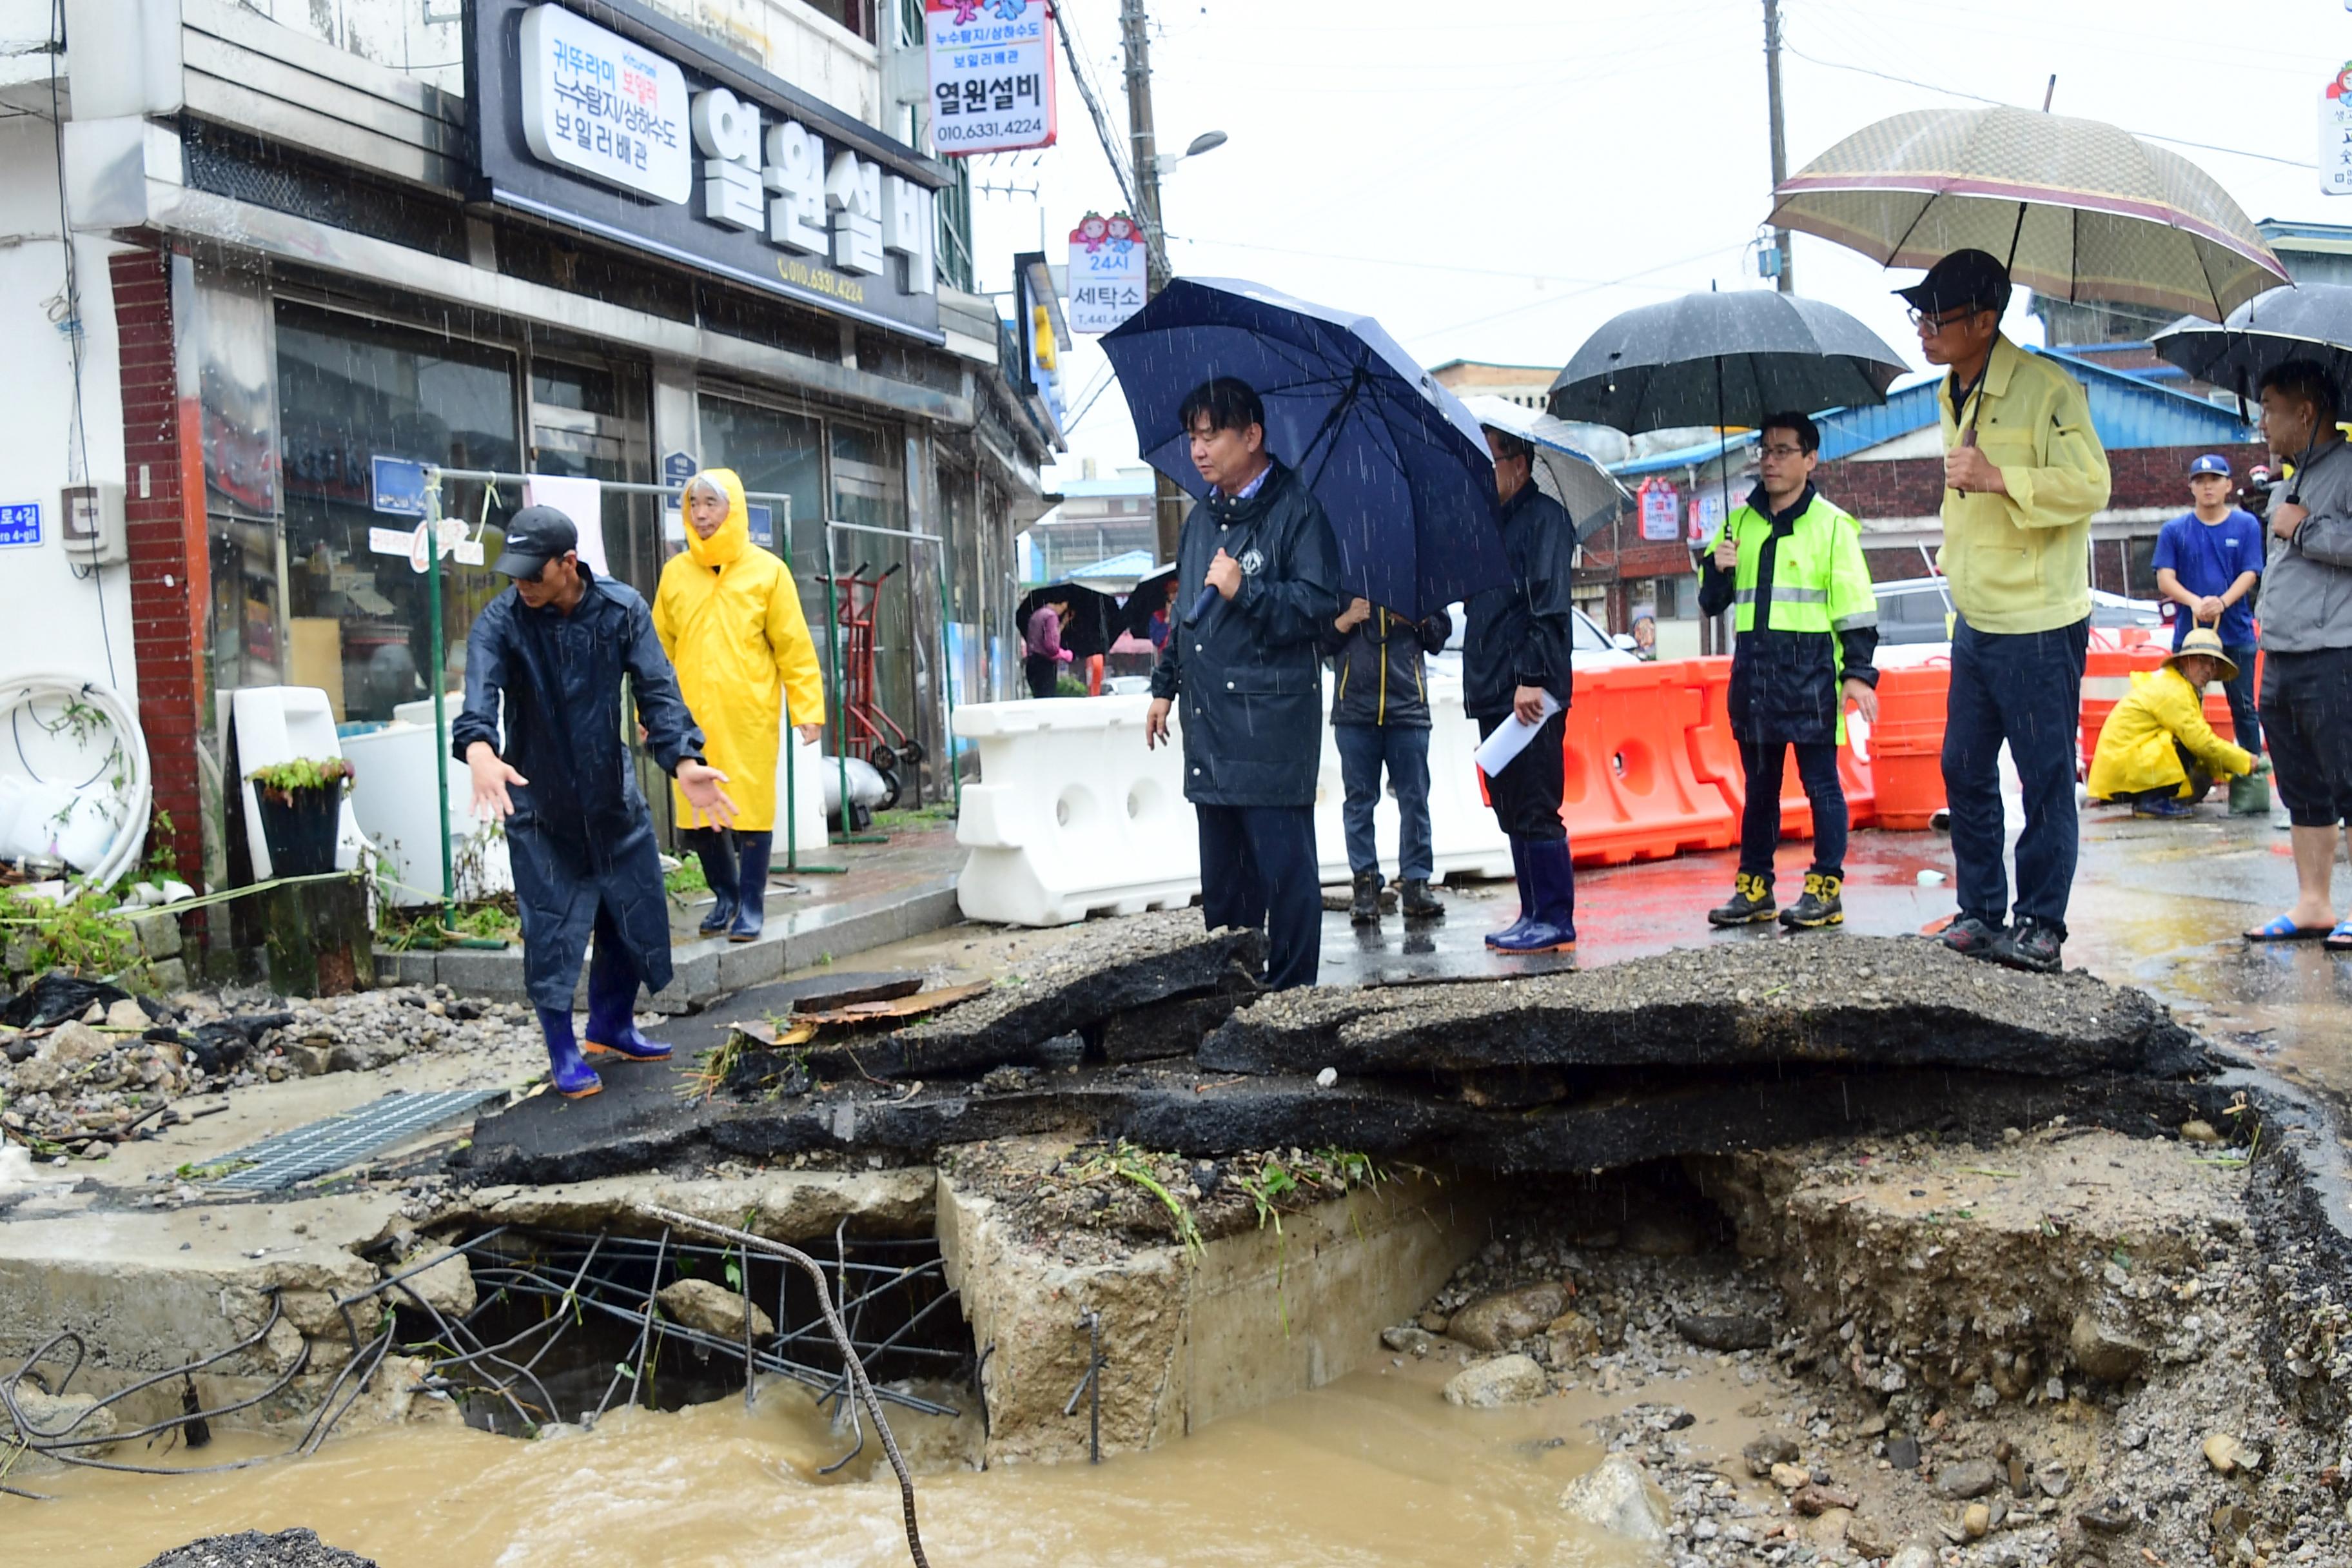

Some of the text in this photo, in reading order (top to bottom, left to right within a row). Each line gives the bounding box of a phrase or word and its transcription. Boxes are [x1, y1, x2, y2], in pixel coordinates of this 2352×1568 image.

[936, 23, 1039, 46] 누수탐지/상하수도
[553, 37, 658, 110] 귀뚜라미 보일러
[954, 50, 1019, 68] 보일러배관
[553, 71, 677, 149] 누수탐지/상하수도
[936, 73, 1041, 117] 열원설비
[555, 108, 647, 172] 보일러배관
[937, 118, 1042, 142] 010.6331.4224
[691, 86, 934, 296] 열원설비
[788, 260, 863, 304] 010.6331.4224
[1090, 255, 1128, 271] 24시
[1074, 286, 1141, 310] 세탁소
